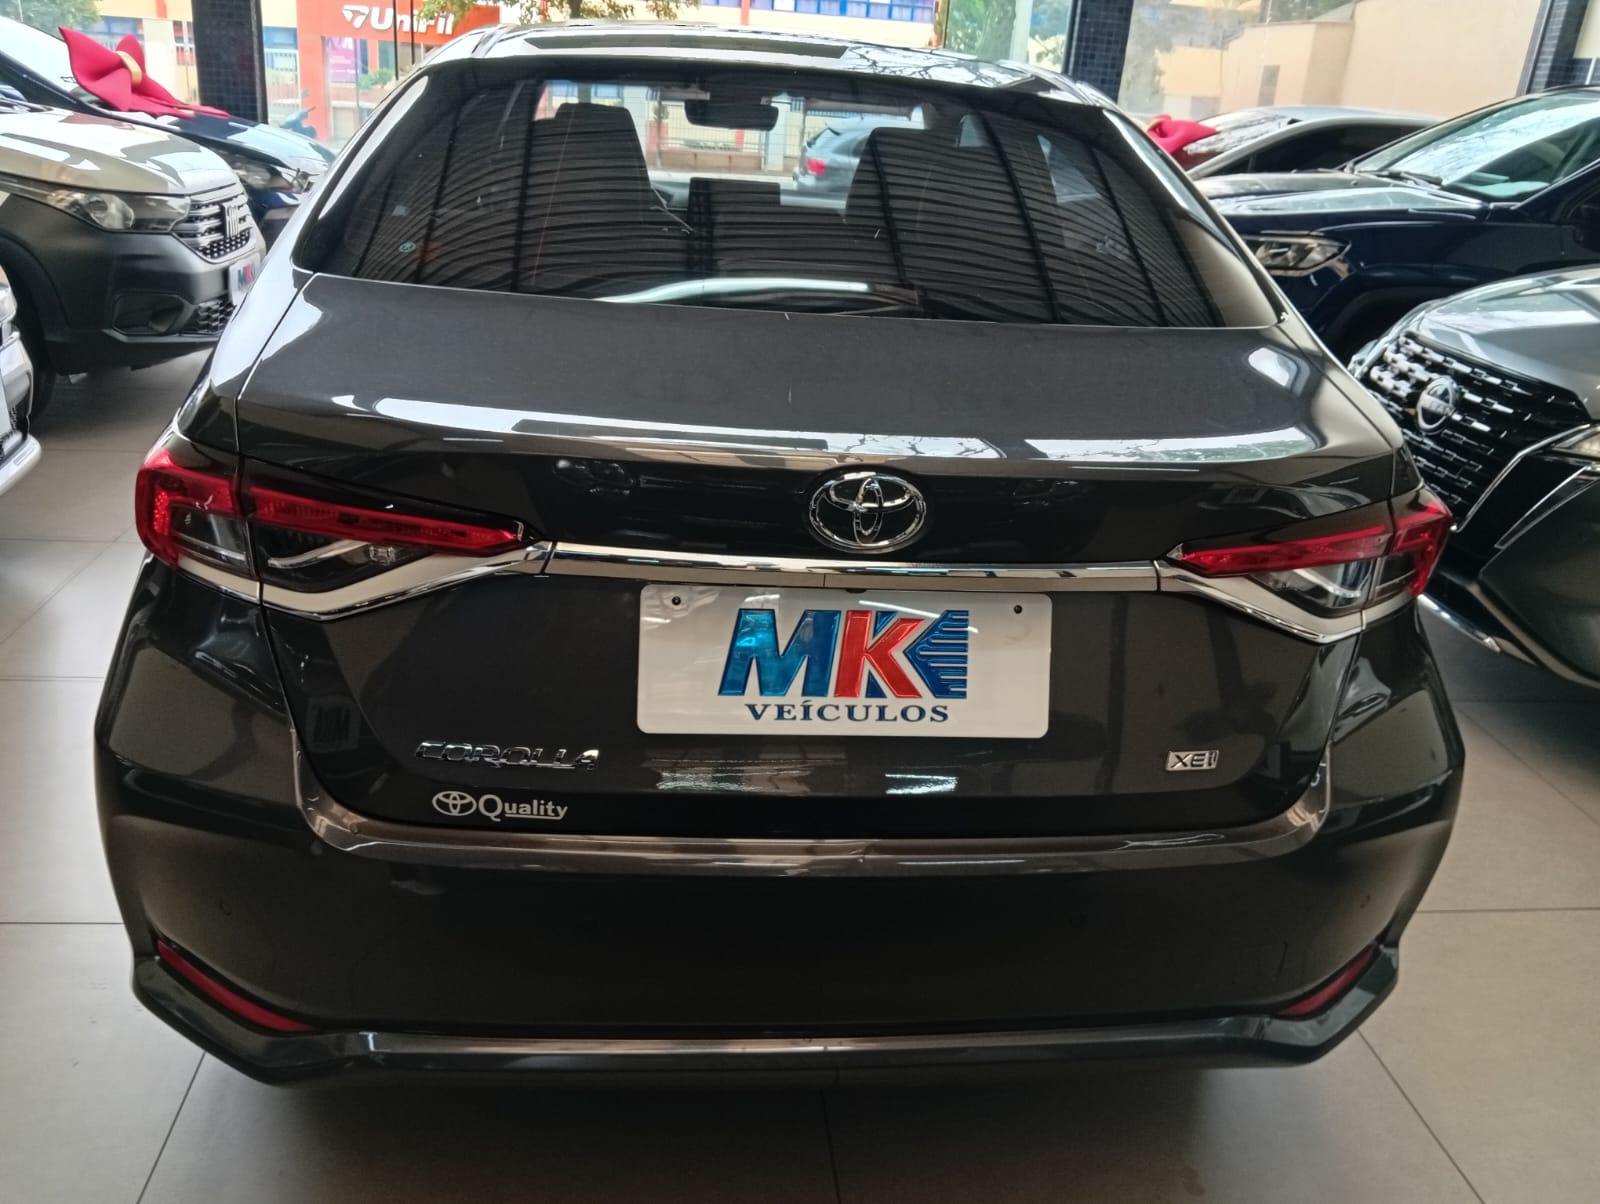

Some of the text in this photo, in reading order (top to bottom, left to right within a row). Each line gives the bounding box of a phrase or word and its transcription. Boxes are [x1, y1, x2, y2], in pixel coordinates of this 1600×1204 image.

[718, 608, 925, 699] MK
[744, 700, 949, 723] VEÍCULOS
[415, 741, 600, 770] COROLLA
[478, 794, 568, 821] Quality
